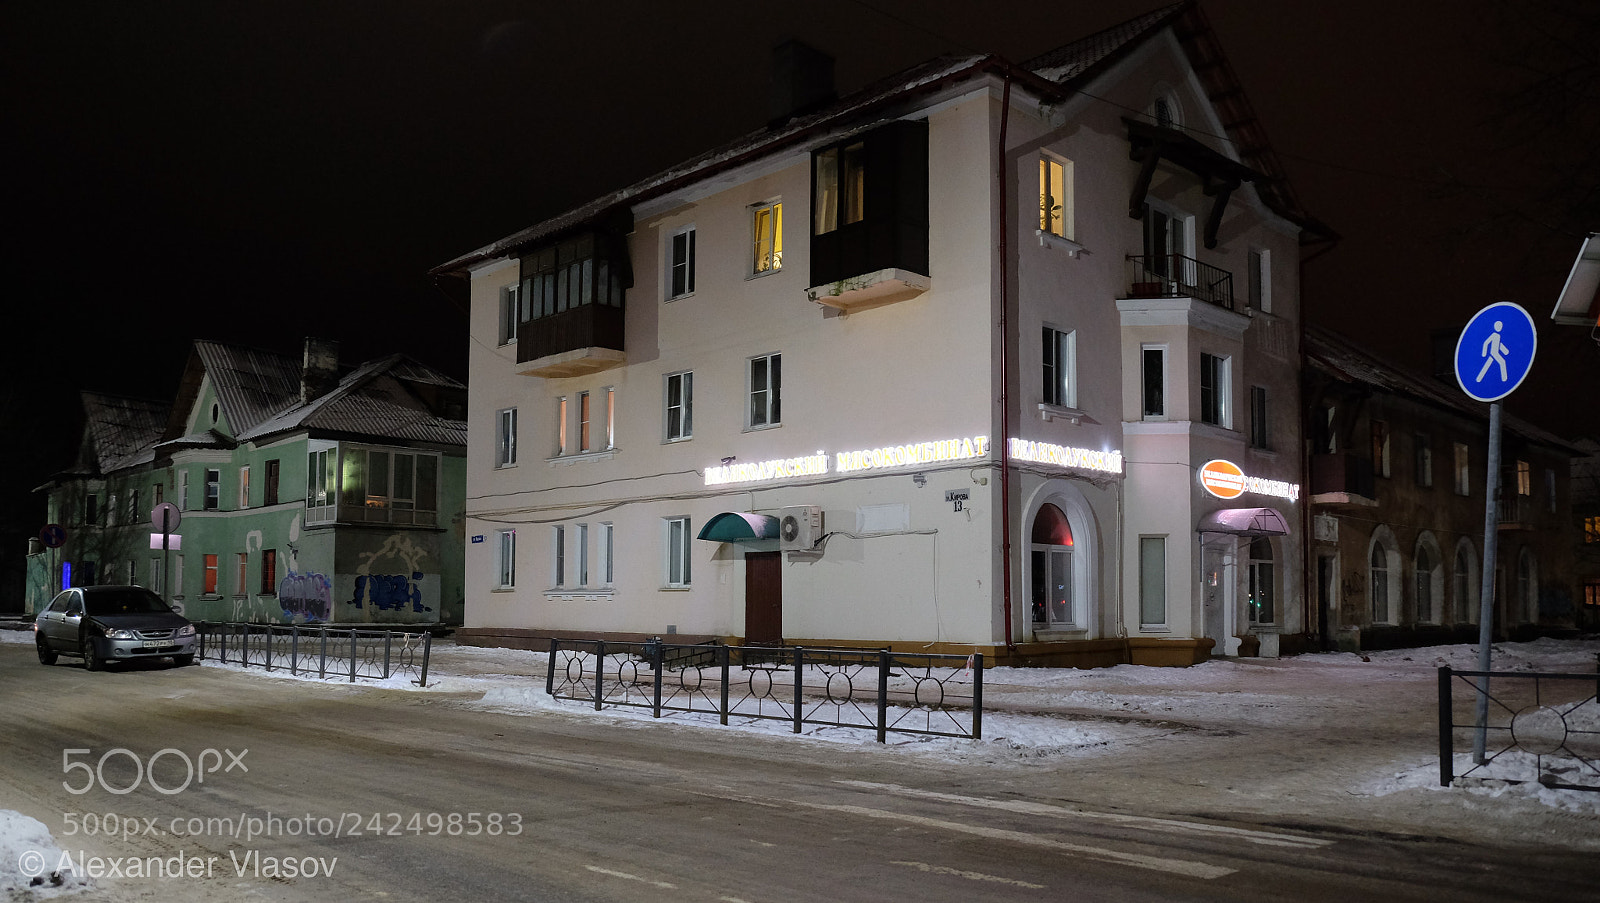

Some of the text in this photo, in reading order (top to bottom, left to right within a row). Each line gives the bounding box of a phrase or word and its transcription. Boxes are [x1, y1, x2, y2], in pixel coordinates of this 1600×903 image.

[836, 436, 989, 472] МЯСОКОМБИНАТ
[1010, 438, 1123, 473] ВЕЛИКОЛУКСКИЙ
[1243, 475, 1300, 500] СОКОМБИНАТ
[954, 500, 963, 512] 13
